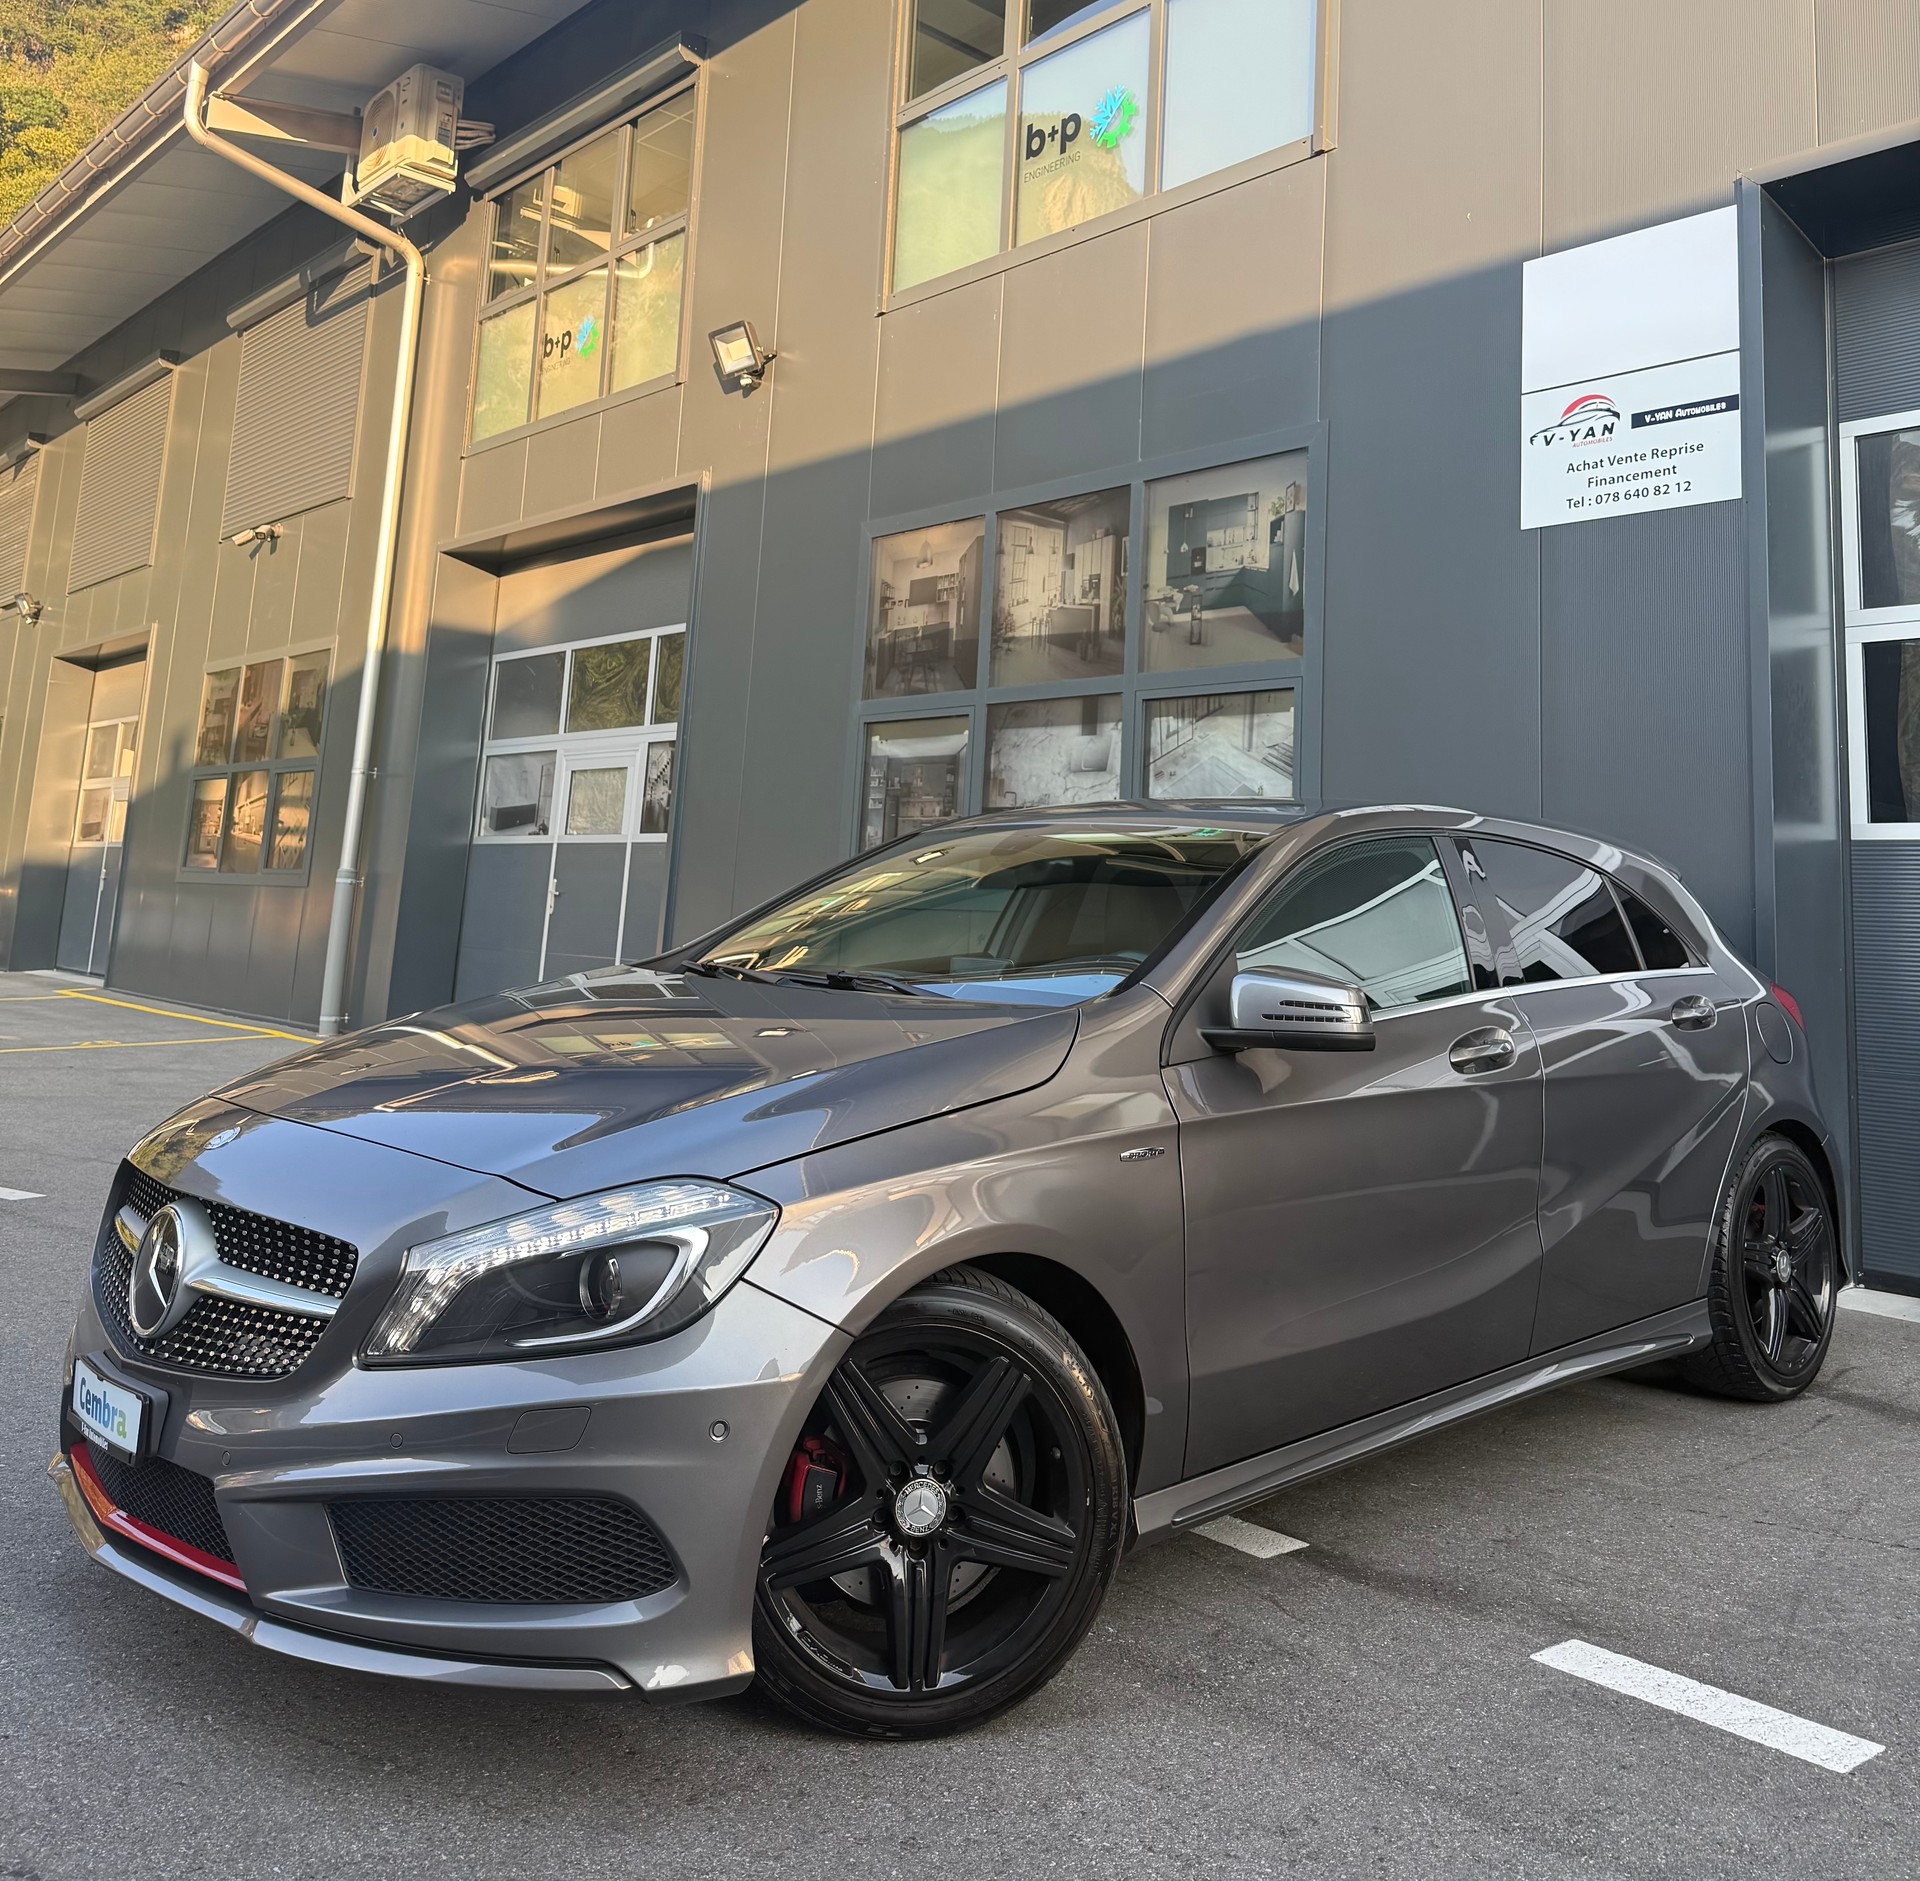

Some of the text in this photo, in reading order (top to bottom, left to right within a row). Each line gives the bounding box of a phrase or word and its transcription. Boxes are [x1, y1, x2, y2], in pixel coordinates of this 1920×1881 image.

[1025, 113, 1082, 160] b+p
[1024, 151, 1081, 183] ENGINEERING
[543, 330, 572, 358] b+p
[1572, 436, 1613, 448] AUTOMOBILES
[1566, 442, 1704, 474] Achat Vente Reprise
[1587, 464, 1677, 488] Financement
[1566, 496, 1585, 509] Tel
[1595, 491, 1620, 505] 078
[1624, 487, 1649, 501] 640
[1653, 484, 1670, 496] 82
[1675, 480, 1692, 493] 12
[79, 1377, 127, 1439] Cembra
